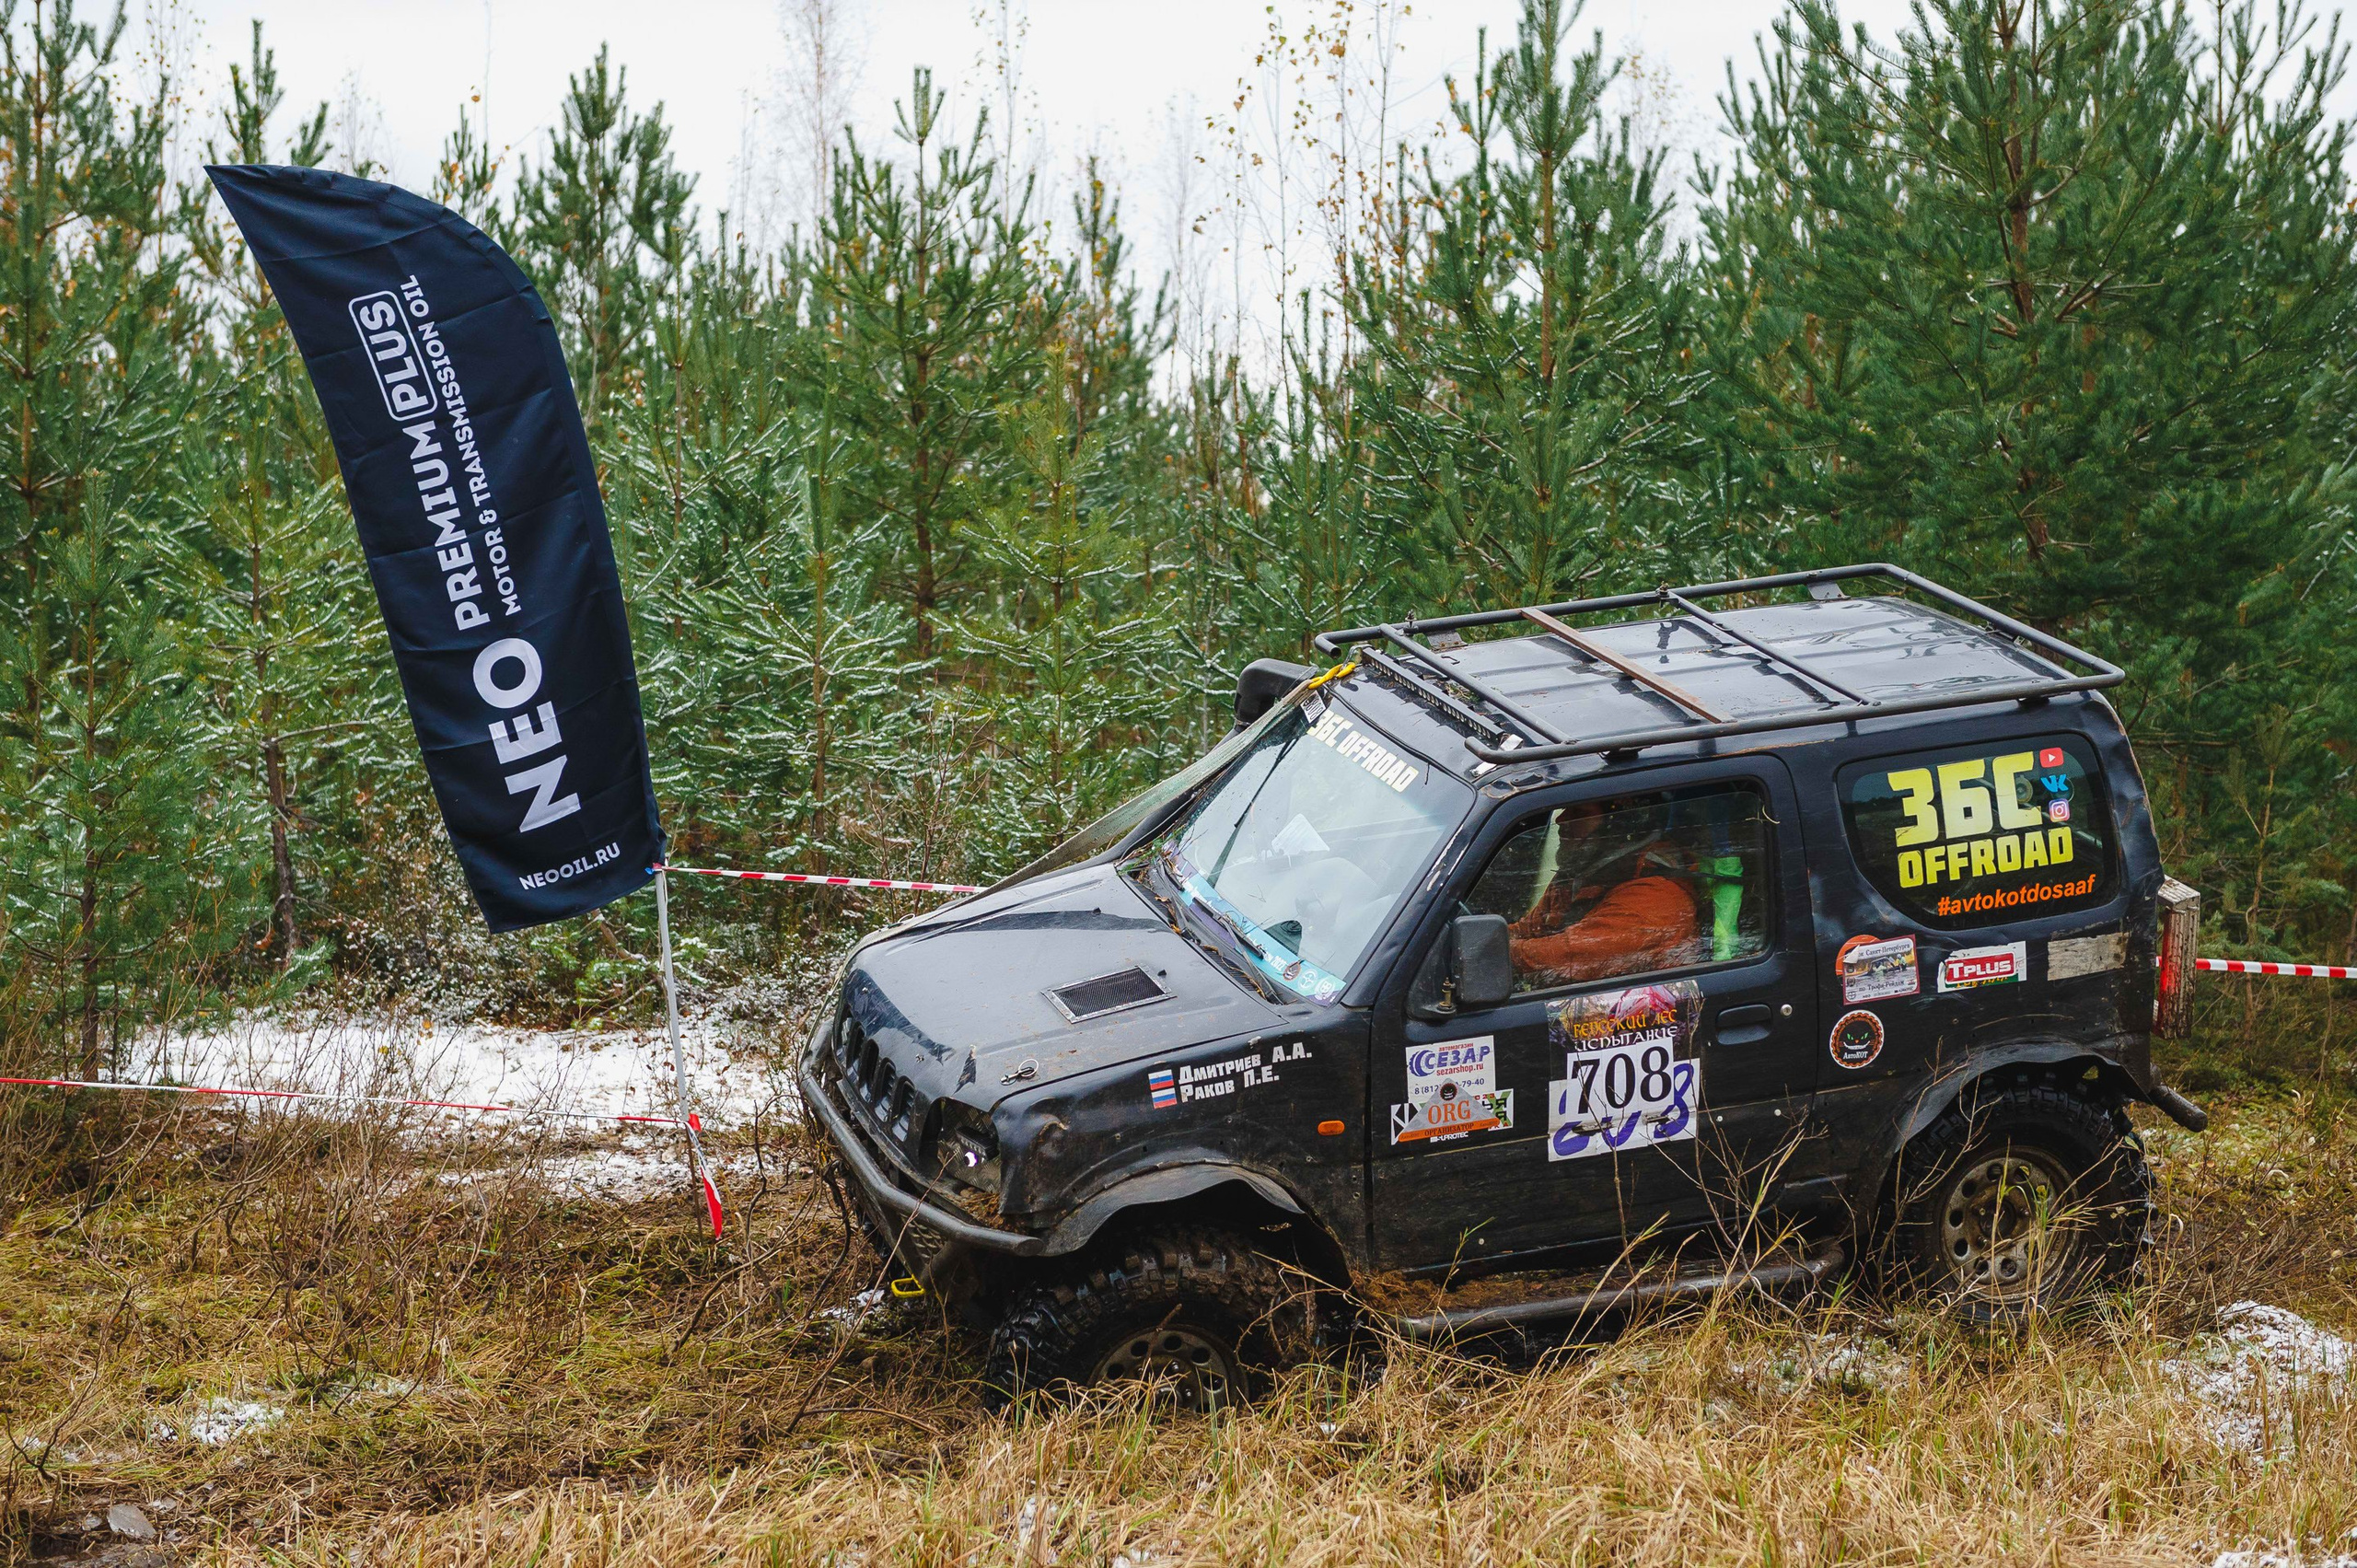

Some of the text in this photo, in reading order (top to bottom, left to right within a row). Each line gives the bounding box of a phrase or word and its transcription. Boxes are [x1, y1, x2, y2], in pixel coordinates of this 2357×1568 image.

[359, 300, 491, 631] PREMIUM PLUS
[400, 274, 522, 616] MOTOR & TRANSMISSION OIL
[472, 638, 581, 833] NEO
[1336, 730, 1420, 793] OFFROAD
[518, 842, 621, 890] NEOOIL.RU
[1897, 826, 2073, 889] OFFROAD
[1937, 874, 2096, 916] #avtokotdosaaf
[1271, 1041, 1313, 1063] А.А.
[1424, 1045, 1491, 1070] СЕЗАР
[1574, 1026, 1678, 1051] ИСПЫТАНИЕ
[1244, 1064, 1280, 1088] П.Е.
[1436, 1063, 1484, 1076] sezarshop.ru
[1571, 1046, 1673, 1114] 708
[1424, 1123, 1474, 1136] ОРГАНИЗАТОР
[1428, 1100, 1471, 1124] ORG
